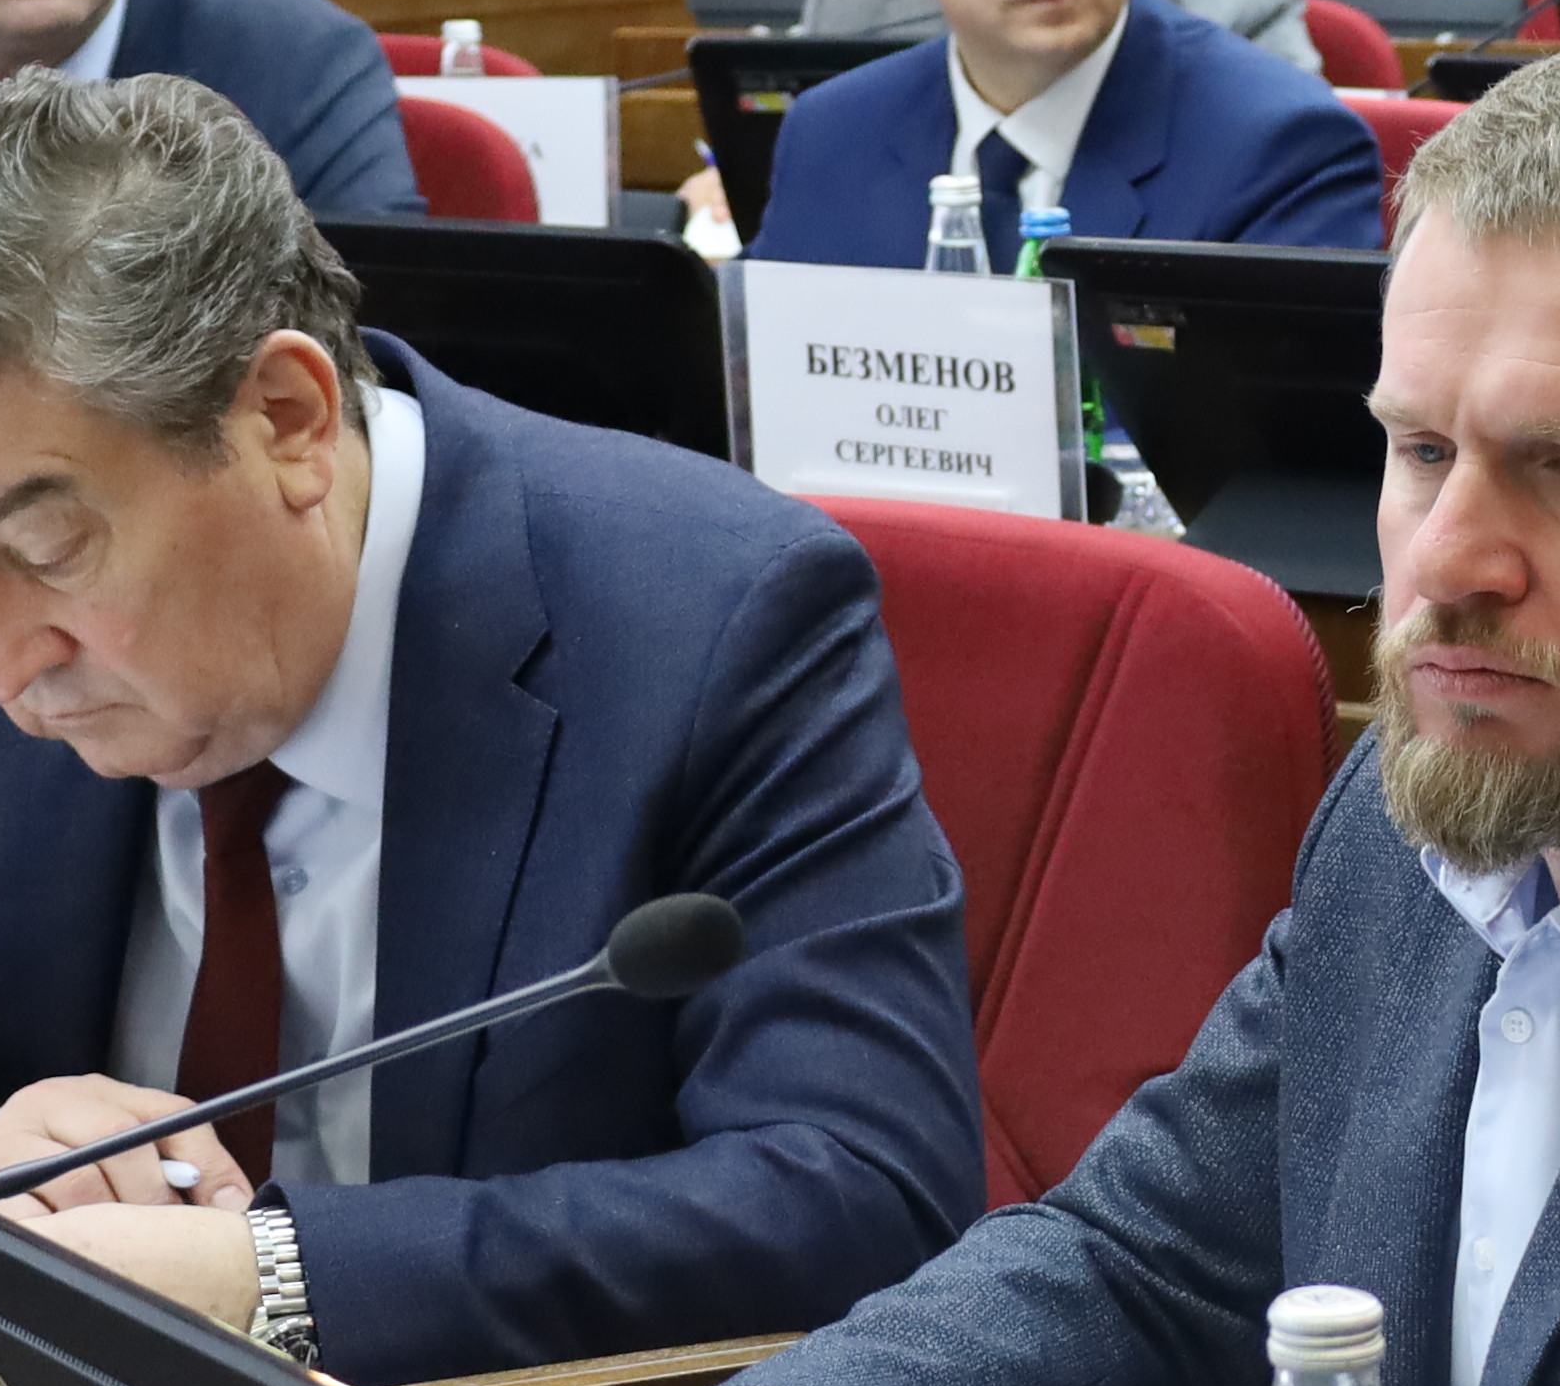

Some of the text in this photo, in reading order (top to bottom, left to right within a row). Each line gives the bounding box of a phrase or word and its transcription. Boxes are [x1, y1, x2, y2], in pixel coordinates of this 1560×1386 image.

[806, 343, 1015, 393] БЕЗМЕНОВ
[876, 404, 948, 431] ОЛЕГ
[835, 440, 993, 477] СЕРГЕЕВИЧ
